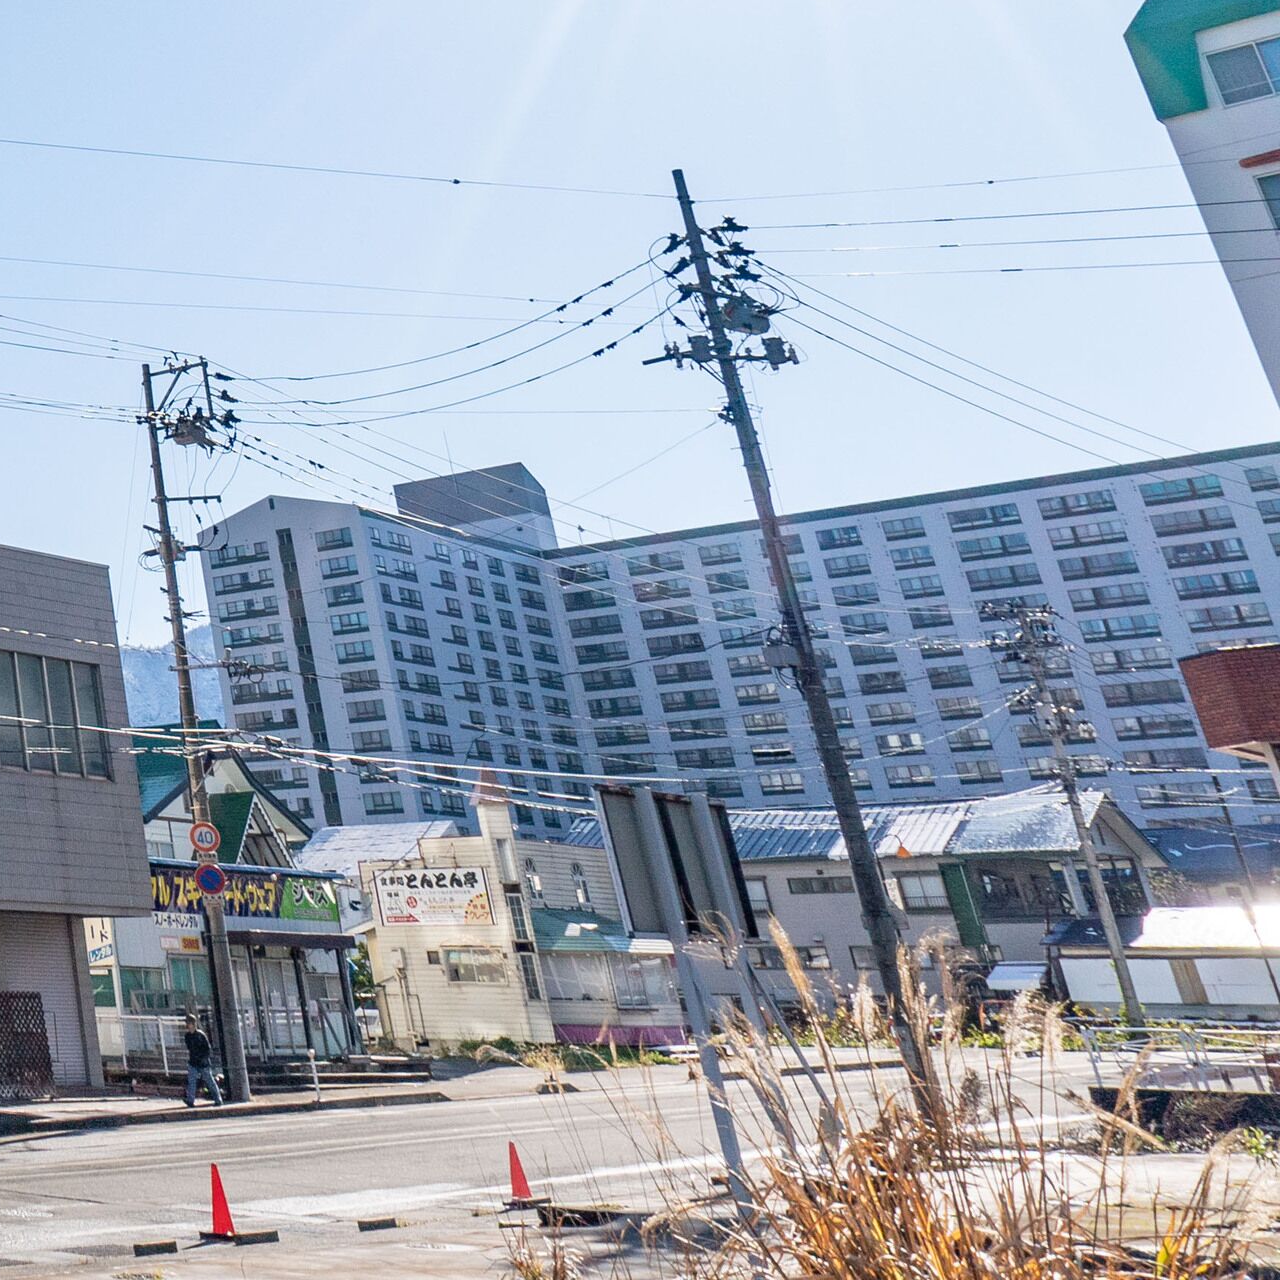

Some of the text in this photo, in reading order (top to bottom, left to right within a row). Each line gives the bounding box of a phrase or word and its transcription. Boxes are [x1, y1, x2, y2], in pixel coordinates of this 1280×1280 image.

[197, 830, 213, 844] 40
[405, 871, 478, 889] とんとん亭
